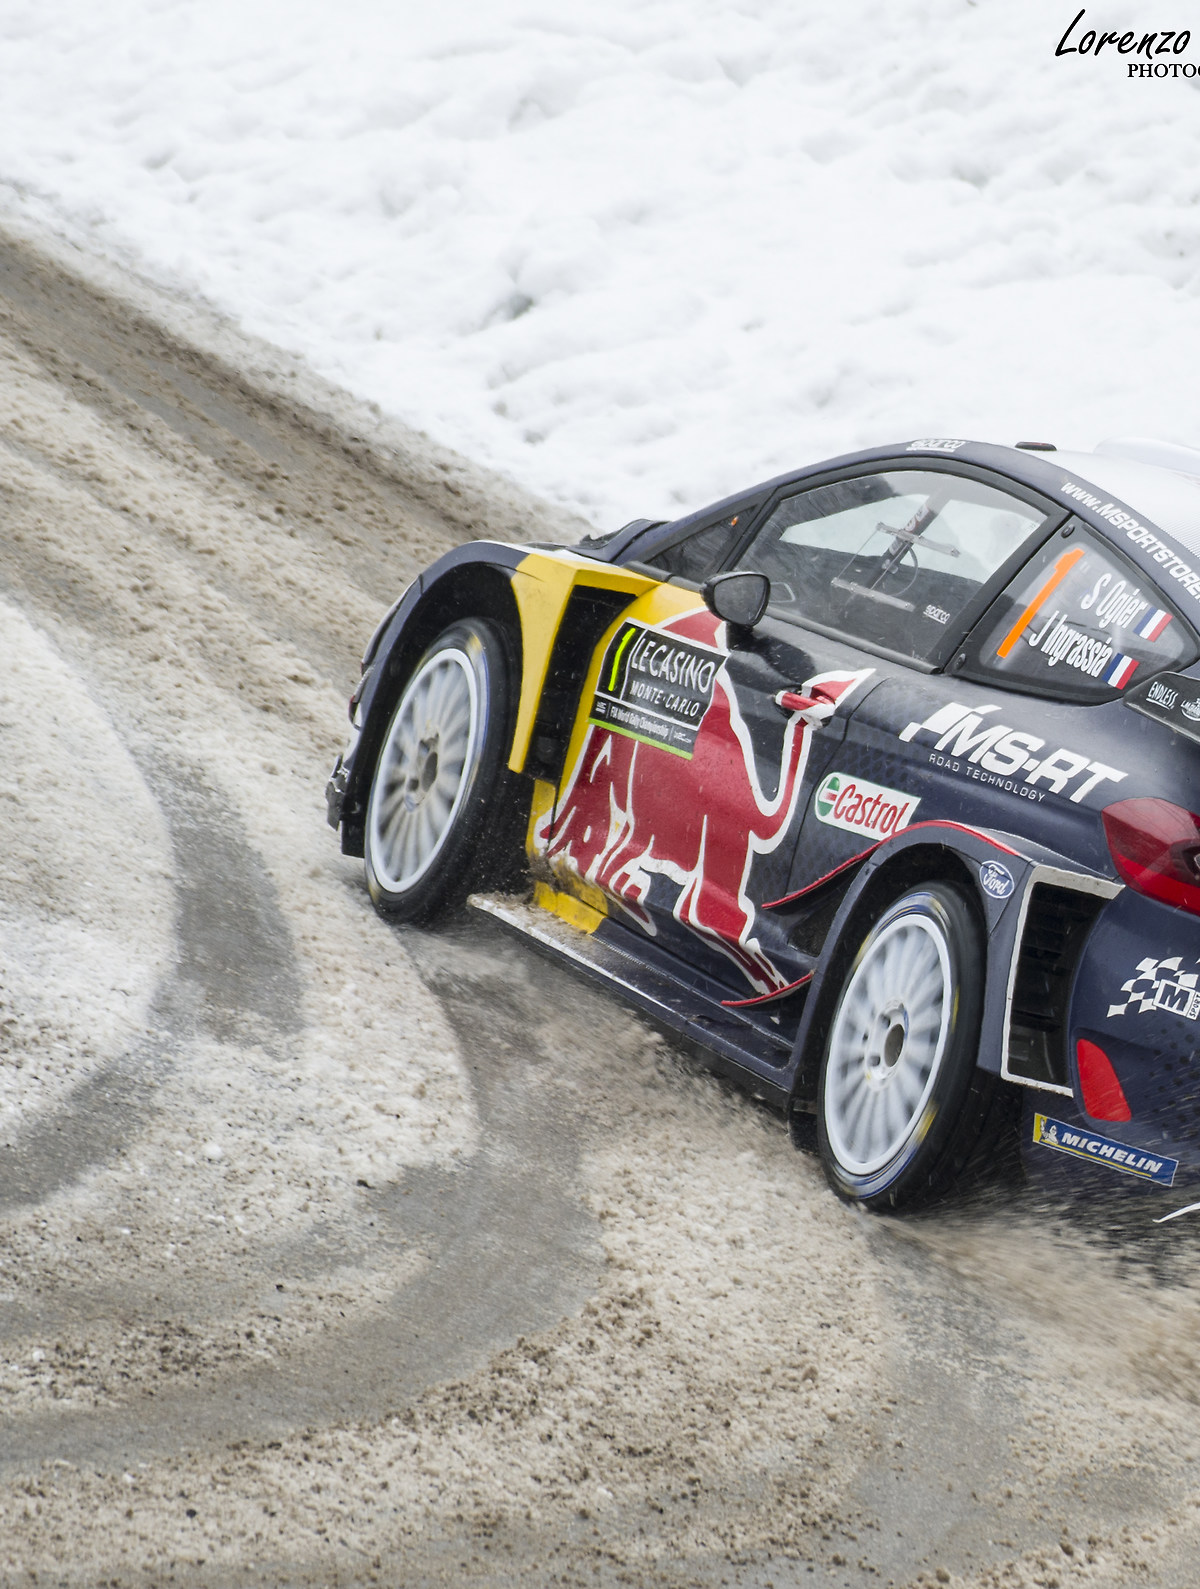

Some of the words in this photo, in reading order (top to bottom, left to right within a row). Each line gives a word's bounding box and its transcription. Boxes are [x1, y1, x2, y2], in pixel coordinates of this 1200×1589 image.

[1080, 572, 1112, 610] S
[1098, 579, 1149, 630] Ogier
[1042, 615, 1114, 679] Ingrassia
[1146, 681, 1179, 709] ENDLESS
[928, 753, 960, 773] ROAD
[965, 765, 1046, 803] TECHNOLOGY
[833, 783, 910, 835] Castrol
[983, 865, 1014, 896] Ford
[1061, 1132, 1163, 1174] MICHELIN
